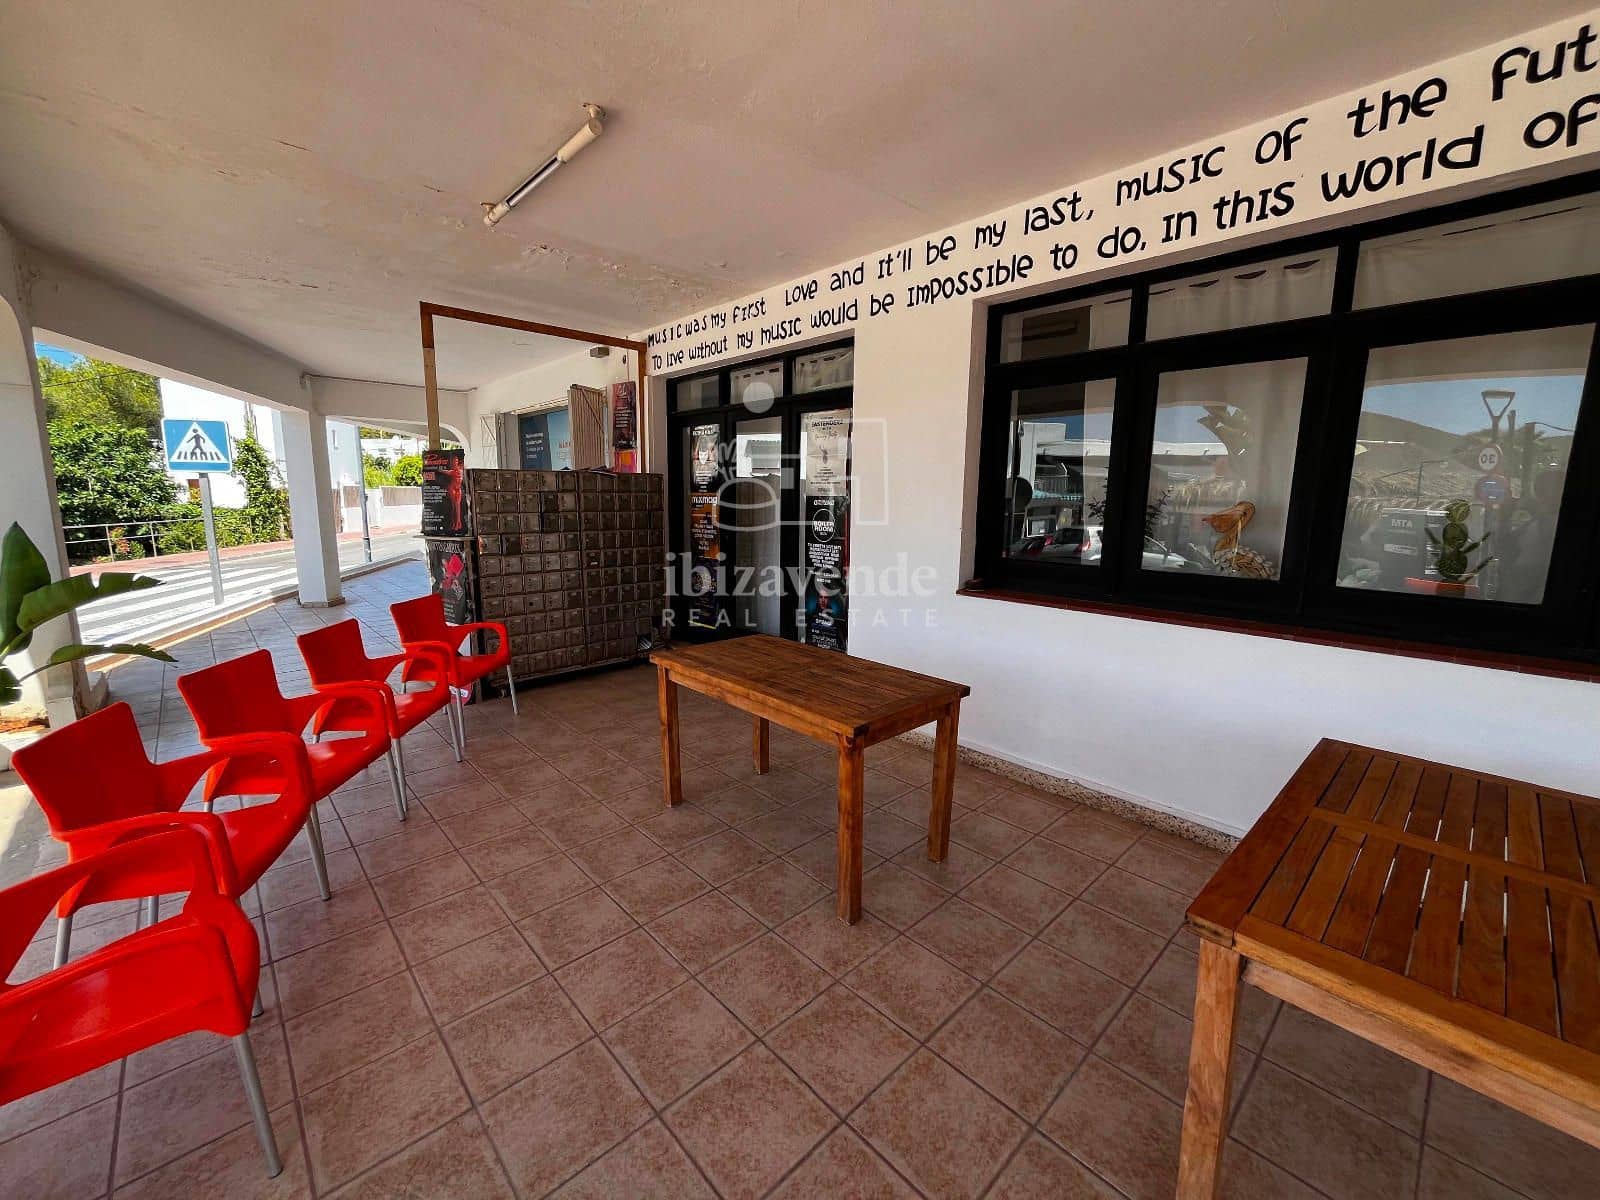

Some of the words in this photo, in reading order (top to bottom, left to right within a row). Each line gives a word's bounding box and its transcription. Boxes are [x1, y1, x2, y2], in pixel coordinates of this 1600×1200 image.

[685, 315, 707, 336] was
[710, 312, 727, 329] my
[830, 262, 864, 291] and
[925, 236, 957, 266] be
[974, 221, 1007, 248] my
[1024, 191, 1095, 235] last,
[1347, 77, 1448, 138] the
[688, 335, 728, 361] without
[736, 331, 754, 350] my
[810, 299, 858, 329] would
[870, 292, 895, 317] be
[1049, 243, 1078, 271] to
[1321, 124, 1485, 202] world
